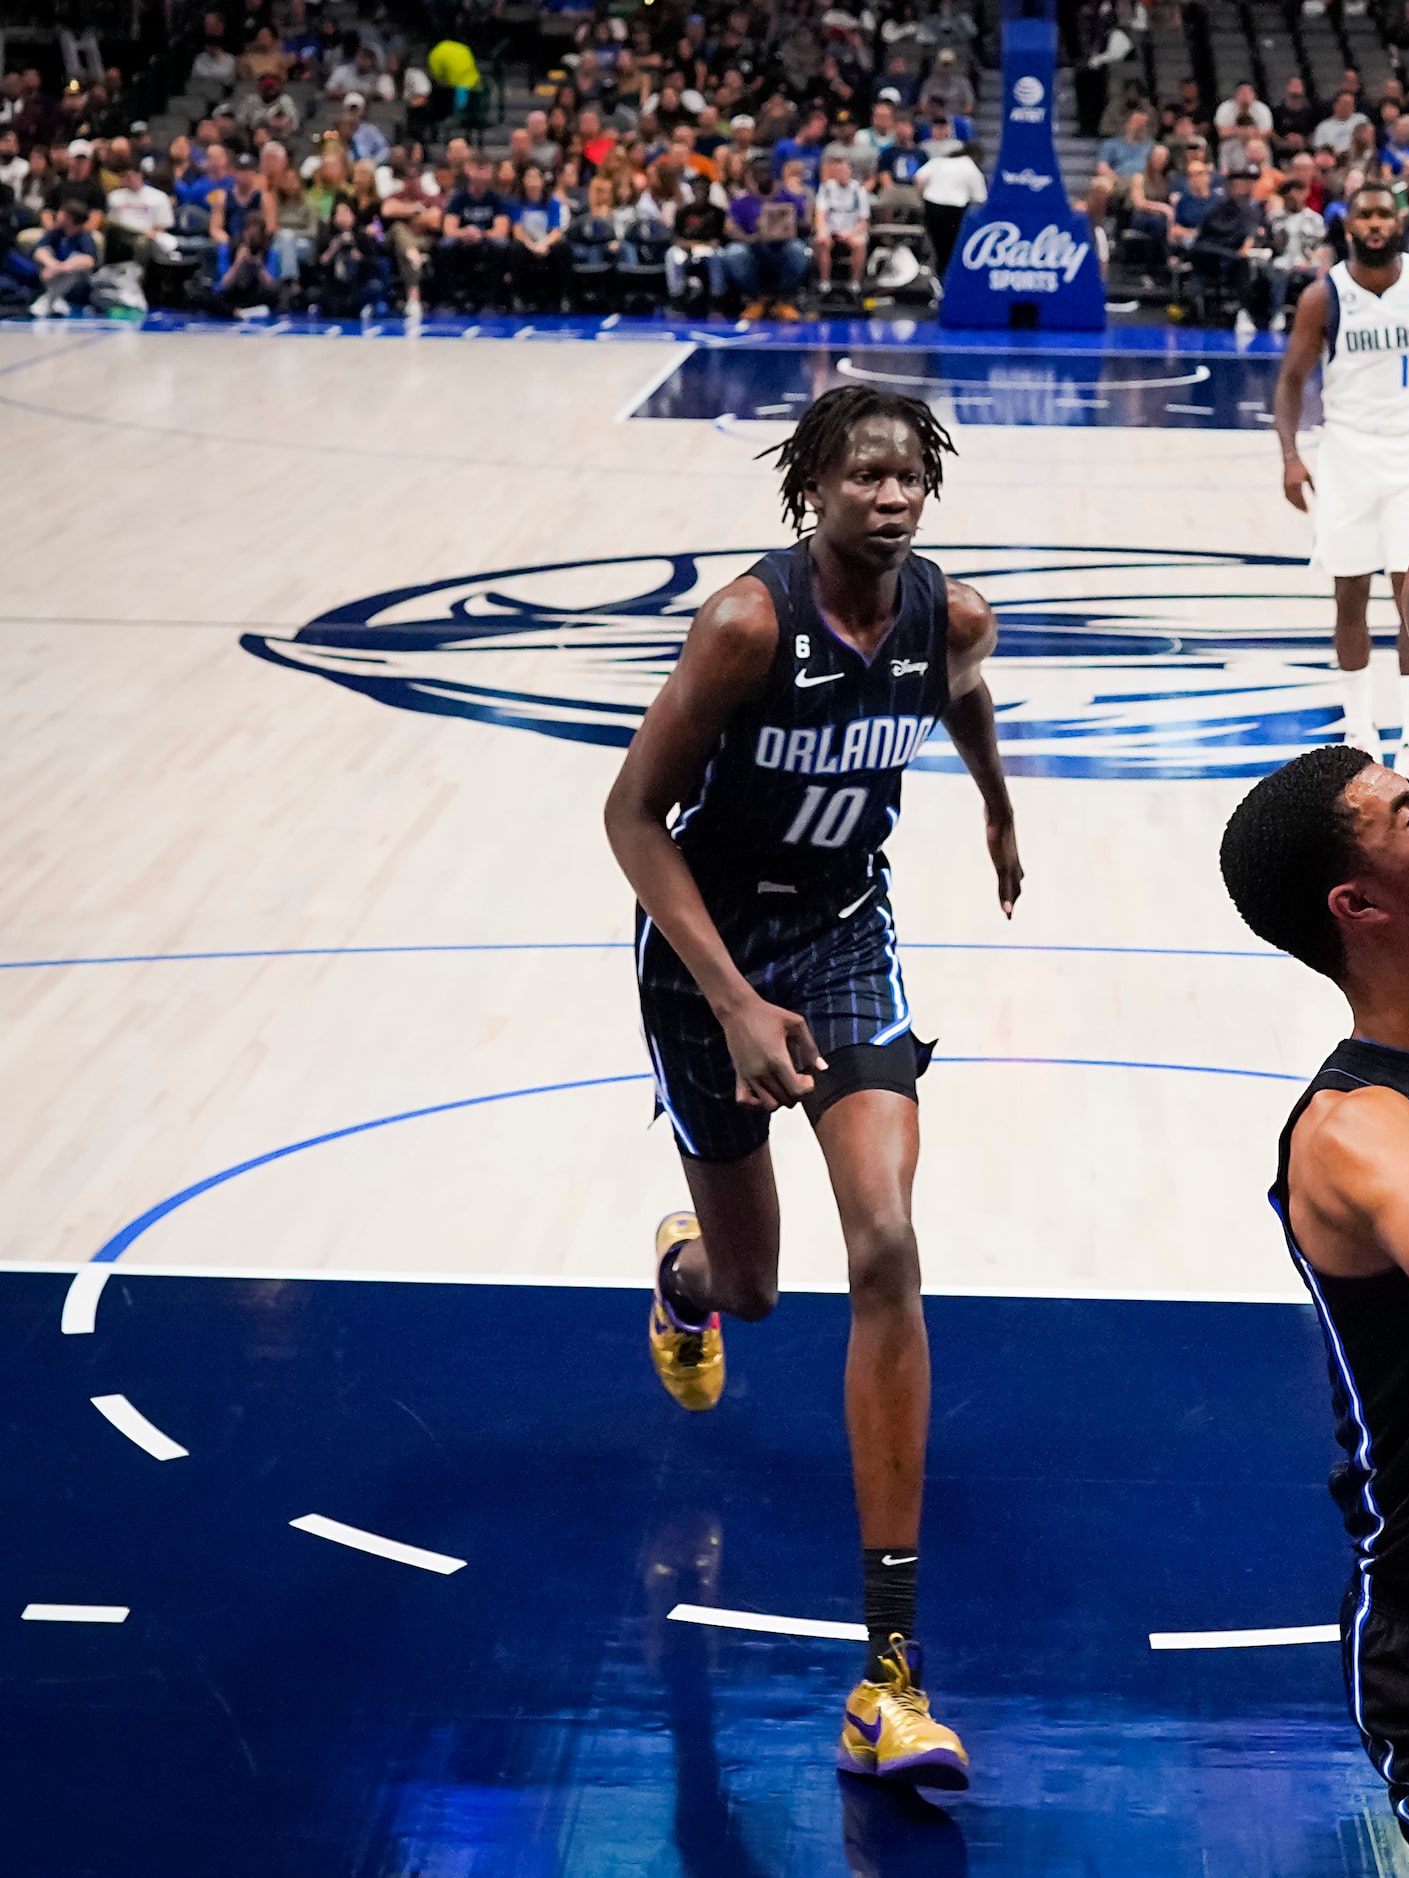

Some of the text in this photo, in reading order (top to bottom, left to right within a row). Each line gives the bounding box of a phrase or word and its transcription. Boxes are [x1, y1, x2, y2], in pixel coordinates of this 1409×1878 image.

[962, 221, 1089, 283] Bally
[988, 270, 1058, 293] SPORTS
[795, 634, 810, 658] 6
[782, 785, 868, 848] 10
